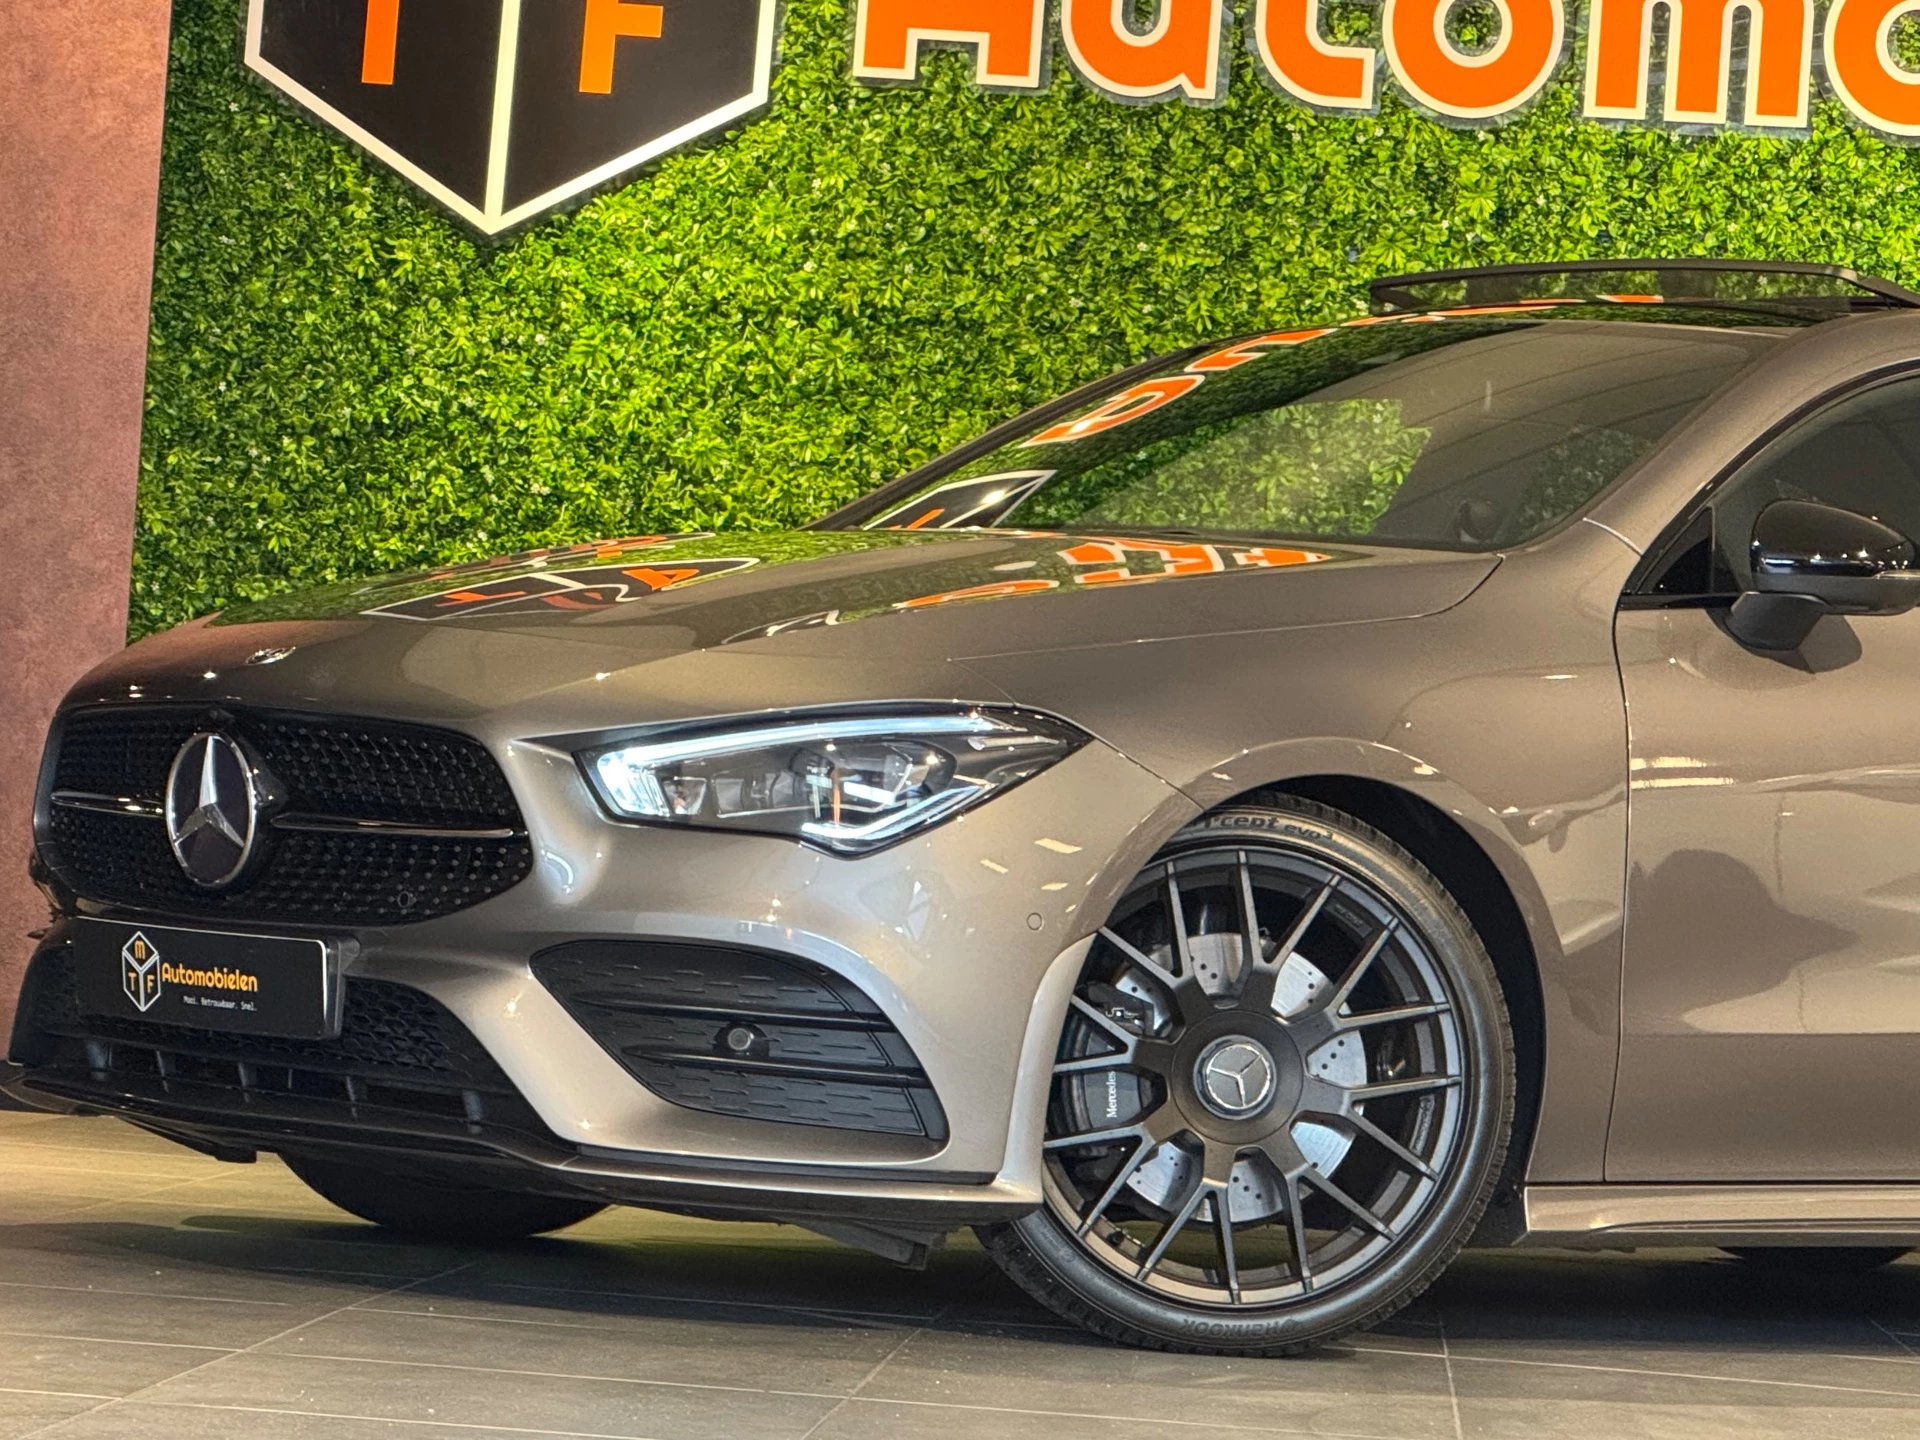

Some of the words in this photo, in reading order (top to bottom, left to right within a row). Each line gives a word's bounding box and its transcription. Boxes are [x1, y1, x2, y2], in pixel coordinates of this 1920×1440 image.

[128, 971, 137, 991] T
[146, 974, 155, 994] F
[161, 962, 258, 992] Automobielen
[1106, 1071, 1117, 1118] Mercedes
